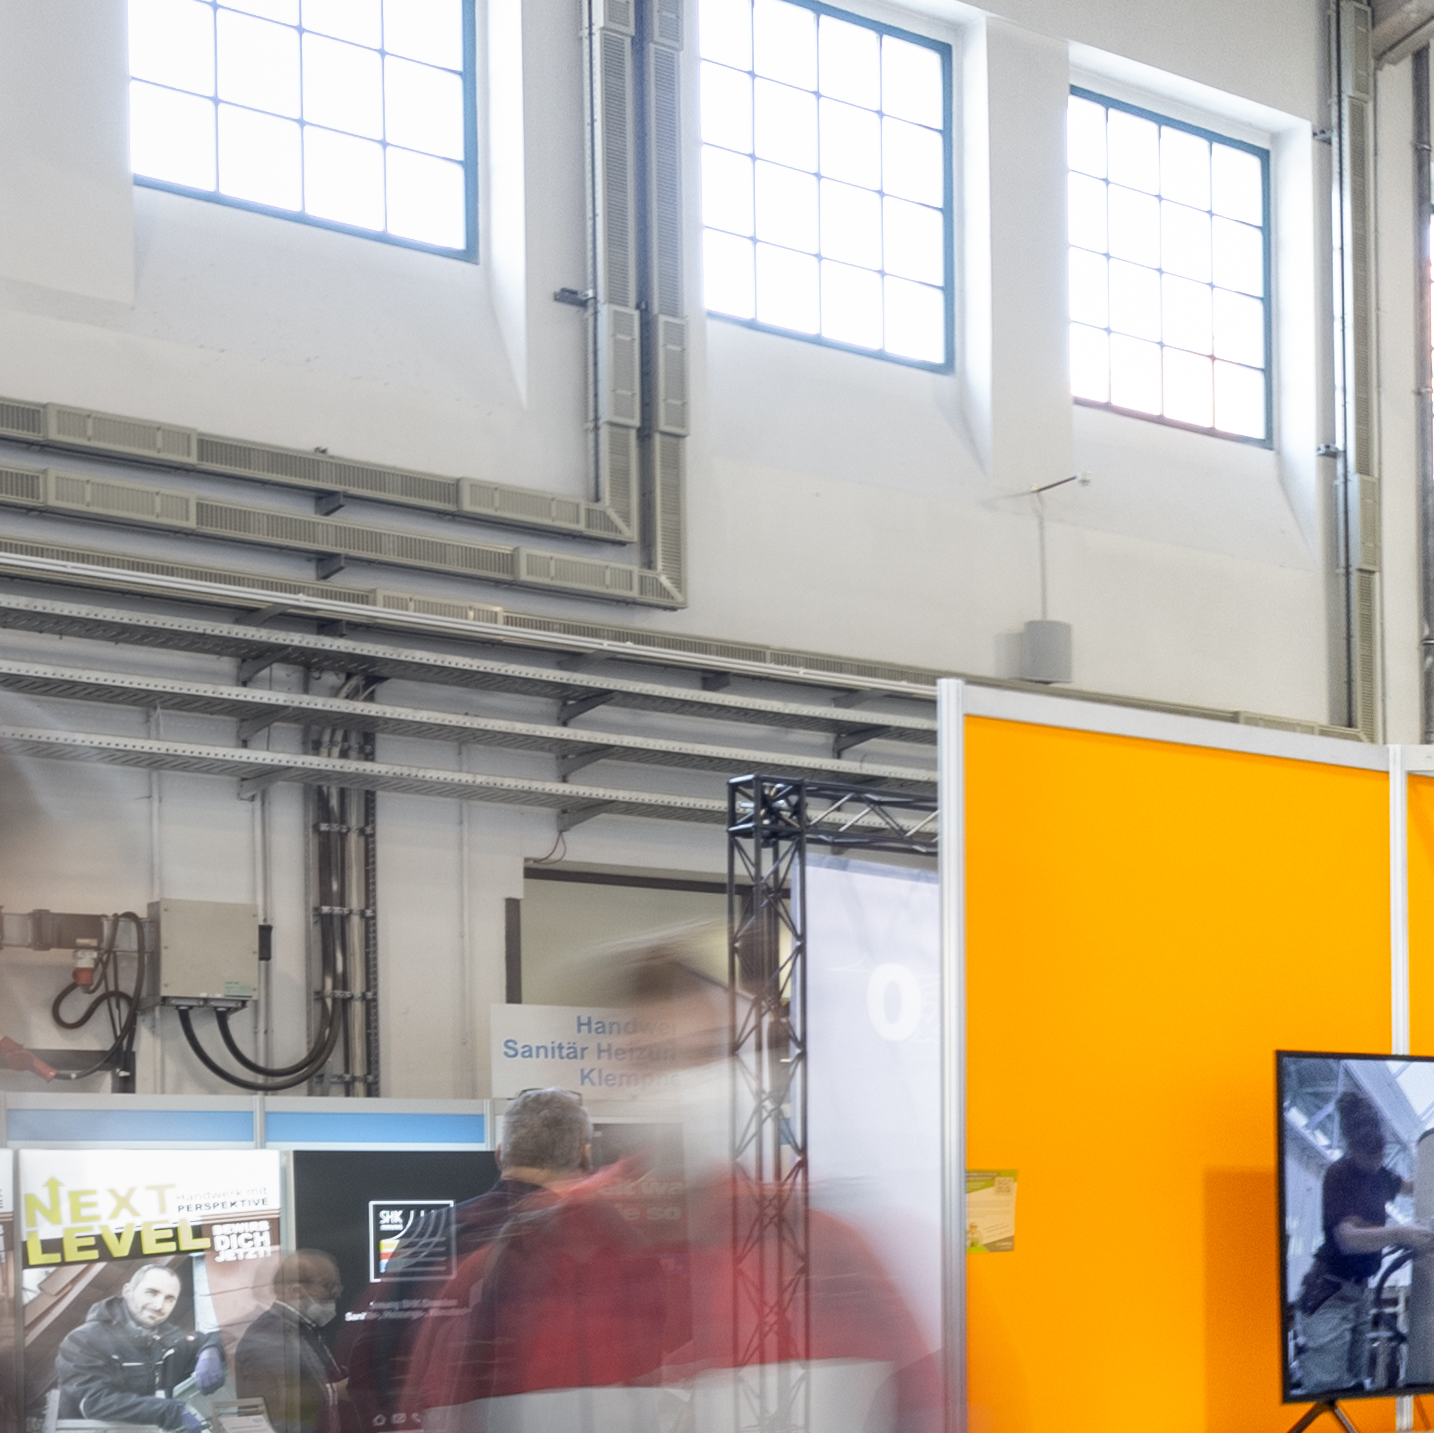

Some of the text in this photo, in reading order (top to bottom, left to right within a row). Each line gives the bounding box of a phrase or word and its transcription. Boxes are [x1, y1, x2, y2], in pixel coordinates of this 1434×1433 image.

[503, 1038, 589, 1060] Sanitär
[24, 1176, 177, 1228] NEXT
[177, 1197, 269, 1213] PERSPEKTIVE
[26, 1218, 212, 1266] LEVEL
[213, 1230, 271, 1252] DICH
